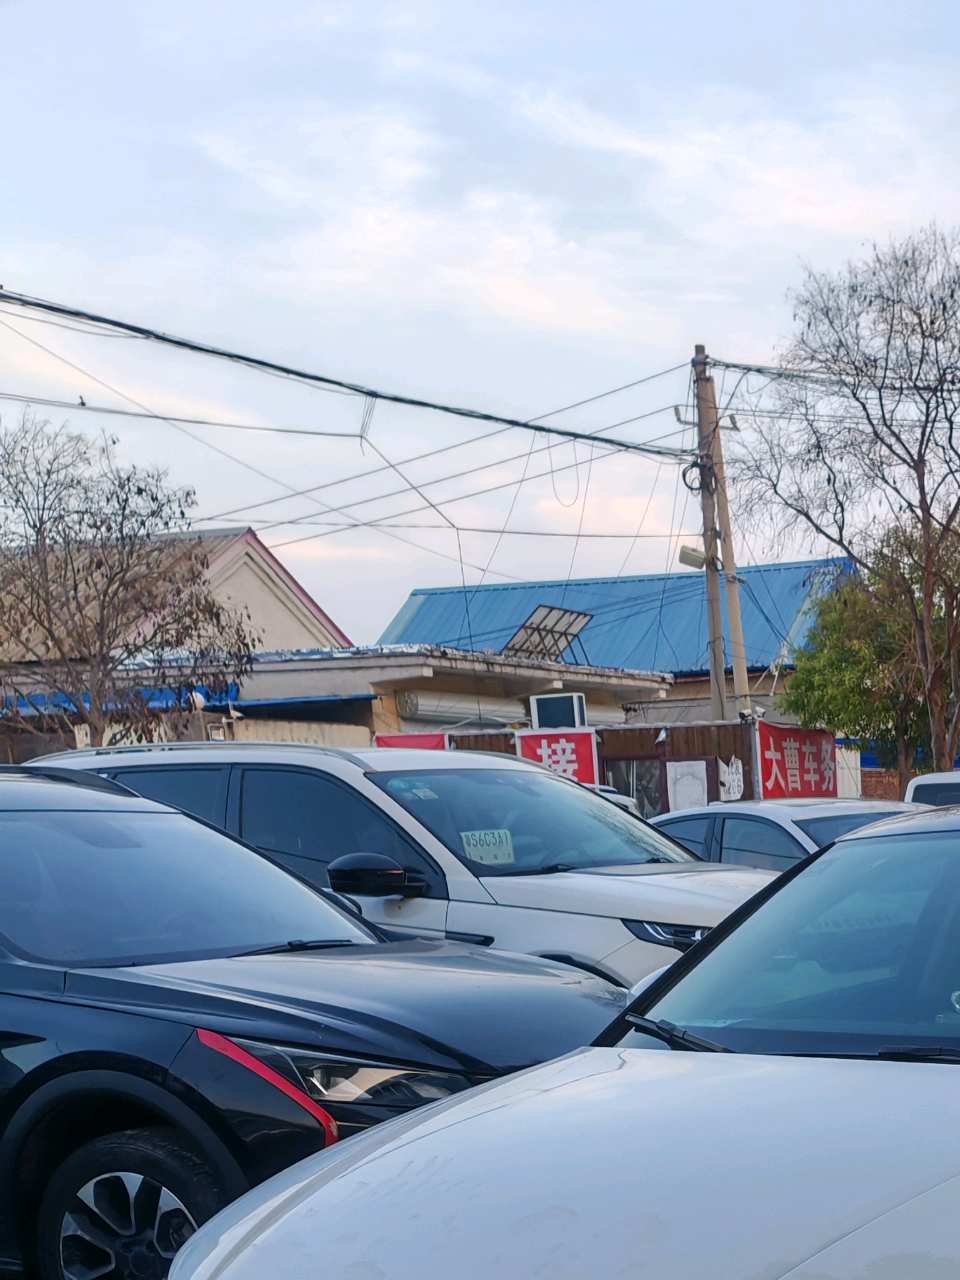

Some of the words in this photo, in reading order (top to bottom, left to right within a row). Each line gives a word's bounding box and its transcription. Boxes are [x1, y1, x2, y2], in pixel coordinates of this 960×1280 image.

[537, 738, 578, 780] 接
[764, 736, 834, 791] 大曹车务
